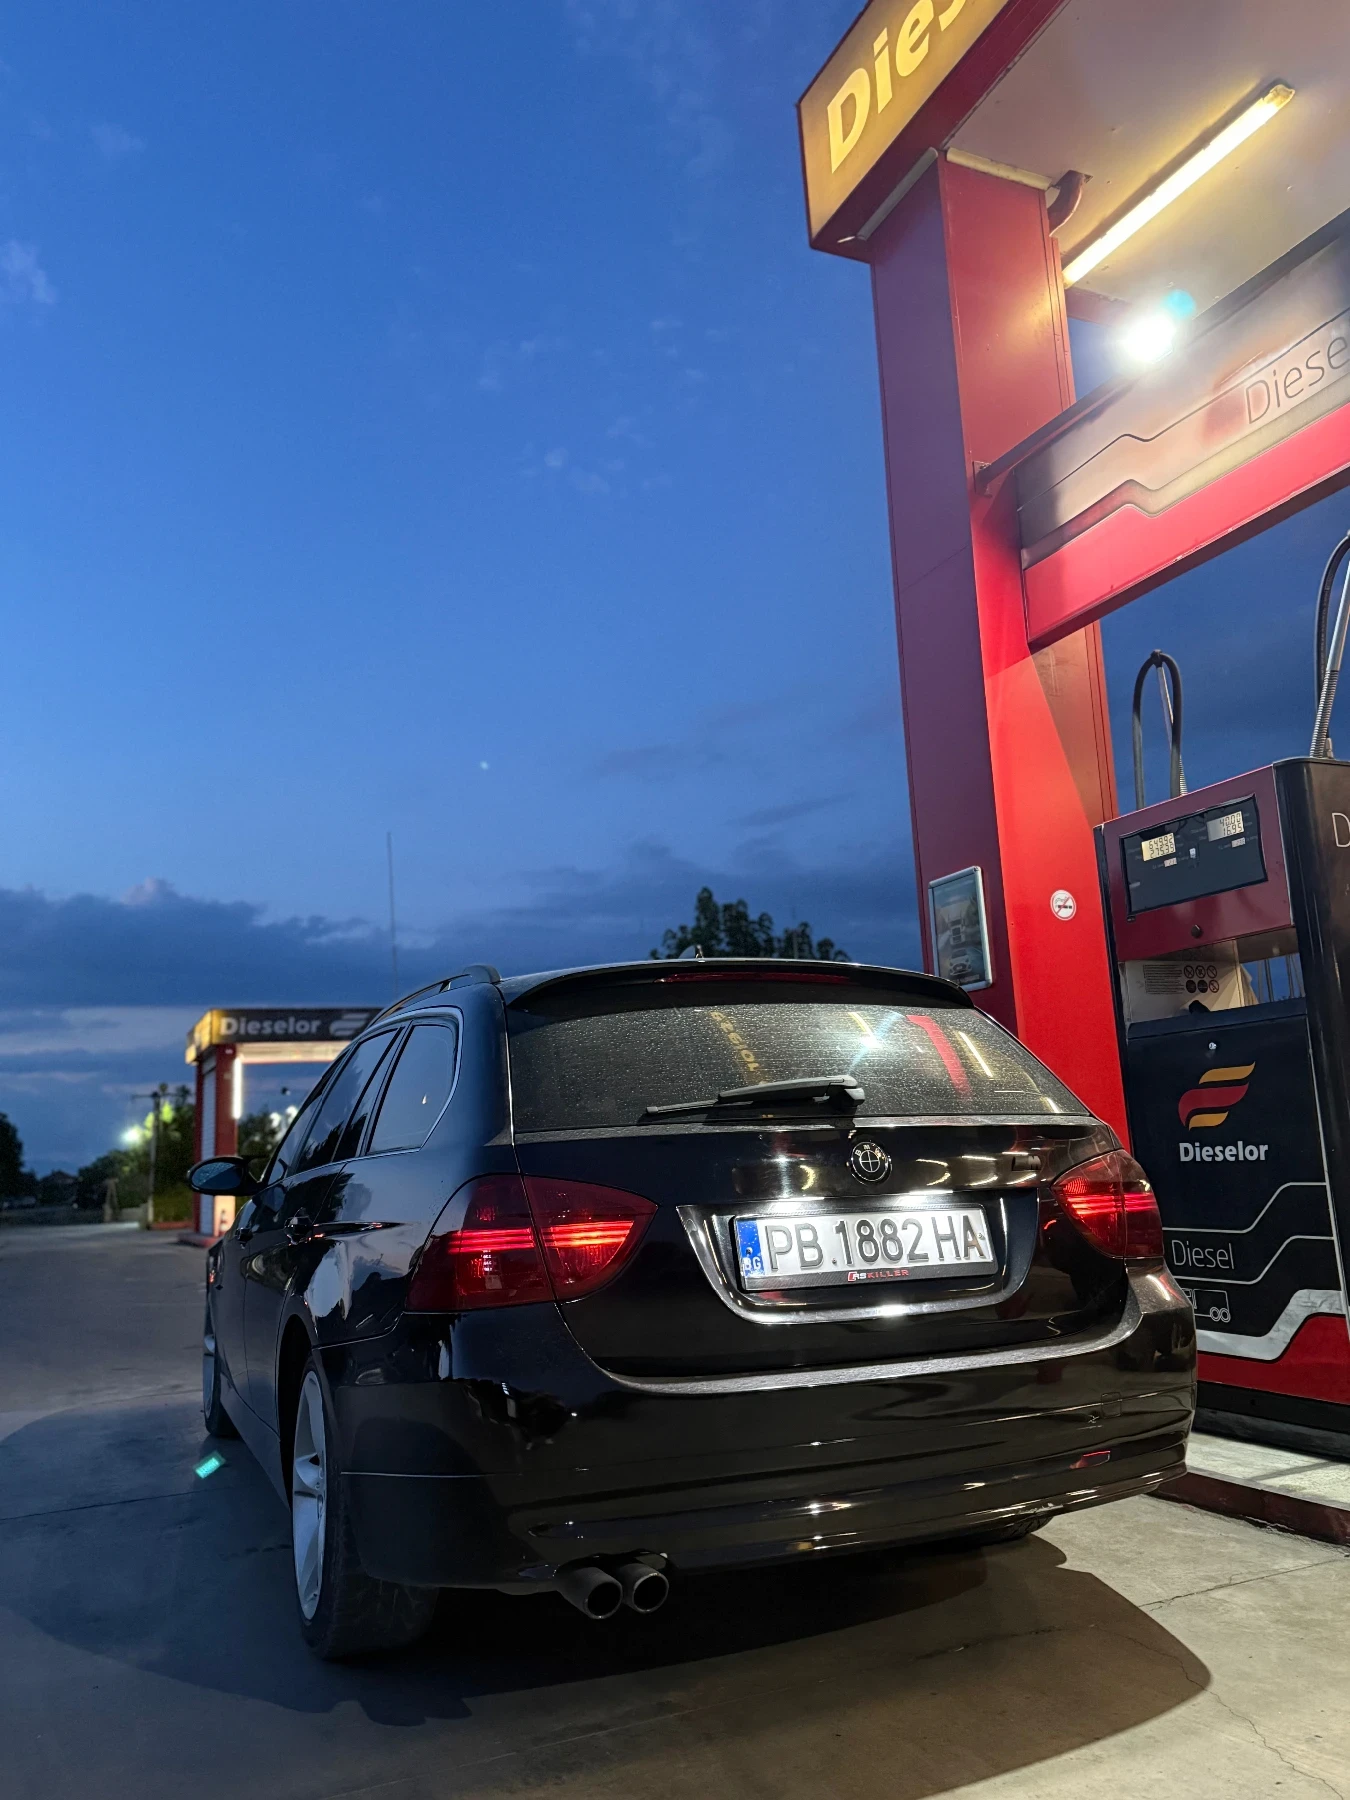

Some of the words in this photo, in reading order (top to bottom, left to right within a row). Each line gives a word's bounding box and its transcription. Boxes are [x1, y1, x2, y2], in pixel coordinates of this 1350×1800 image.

[220, 1016, 321, 1036] Dieselor
[1179, 1141, 1268, 1162] Dieselor
[742, 1256, 762, 1271] BG
[1171, 1239, 1235, 1270] Diesel
